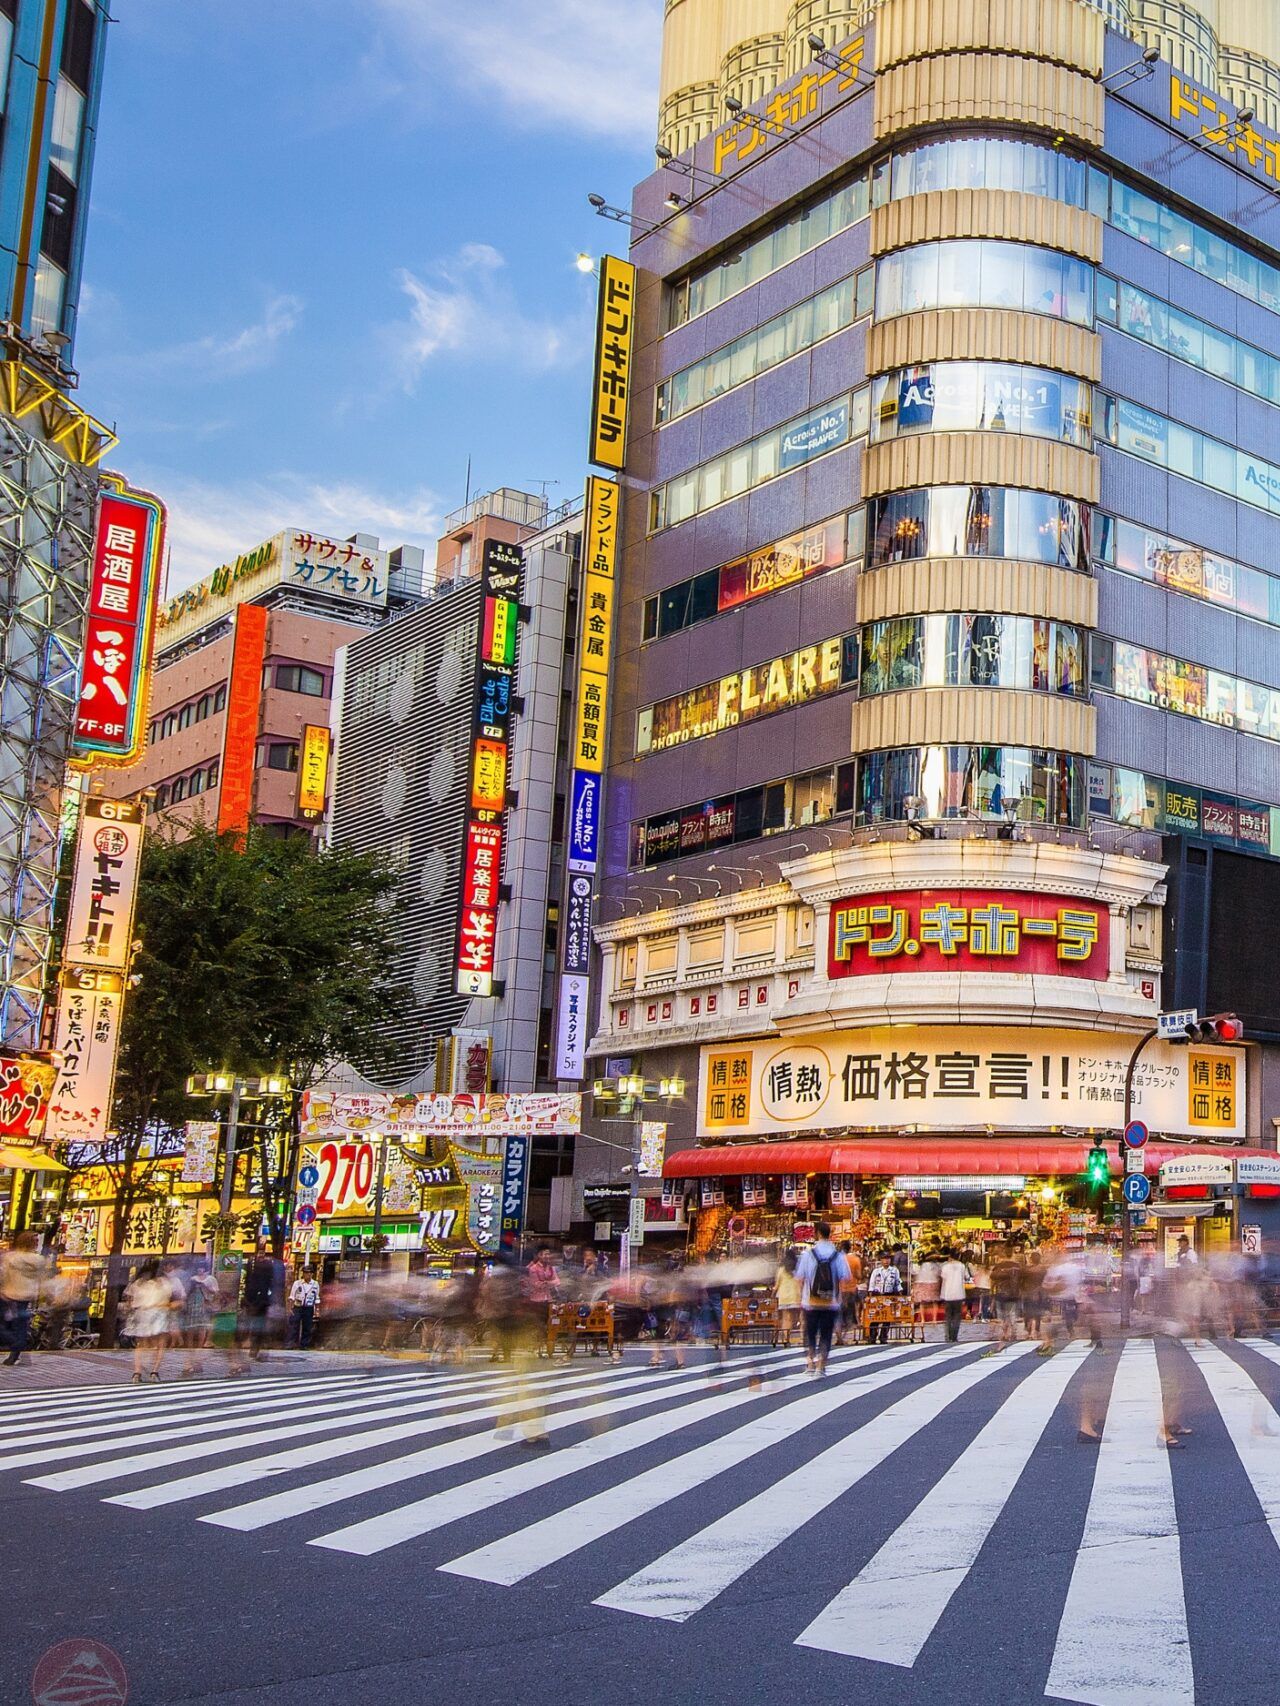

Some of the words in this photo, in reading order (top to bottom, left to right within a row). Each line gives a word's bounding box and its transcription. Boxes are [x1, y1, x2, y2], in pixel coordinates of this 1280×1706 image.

[591, 486, 615, 573] ブランド品
[98, 524, 136, 613] 居酒屋
[210, 565, 231, 596] Big
[233, 541, 274, 582] Lemon
[291, 557, 386, 598] カプセル
[586, 591, 609, 658] 貴金属
[81, 630, 128, 706] つぼ八
[483, 663, 496, 671] New
[717, 637, 841, 722] FLARE
[484, 679, 496, 697] de
[495, 676, 510, 715] Castle
[480, 699, 495, 724] Elle
[1114, 681, 1170, 708] PHOTO
[1175, 697, 1235, 726] STUDIO
[580, 682, 603, 761] 高額買取
[652, 729, 690, 752] PHOTO
[692, 712, 740, 740] STUDIO
[100, 803, 132, 820] 6F
[303, 808, 318, 817] 6F
[478, 810, 496, 822] 6F
[709, 809, 734, 827] 時計
[1166, 792, 1198, 821] 販売
[1204, 806, 1234, 824] ブランド
[574, 808, 584, 845] TRAVEL
[682, 818, 706, 836] ブランド
[1239, 813, 1269, 832] 時計
[471, 848, 493, 907] 居楽屋
[87, 854, 123, 945] ヤキトリ
[78, 974, 112, 990] 5F
[567, 994, 580, 1053] 写真スタジオ
[563, 1056, 578, 1071] 5F
[710, 1057, 749, 1087] 情熱
[1192, 1058, 1233, 1087] 情熱
[767, 1061, 822, 1103] 情熱
[710, 1092, 747, 1120] 価格
[1192, 1094, 1232, 1121] 価格
[315, 1143, 374, 1215] 270
[415, 1166, 451, 1184] カラオケ
[504, 1141, 525, 1215] カラオケ
[1129, 1180, 1140, 1199] P
[418, 1209, 459, 1239] 747
[479, 1183, 495, 1245] カラオケ
[503, 1217, 519, 1230] B1
